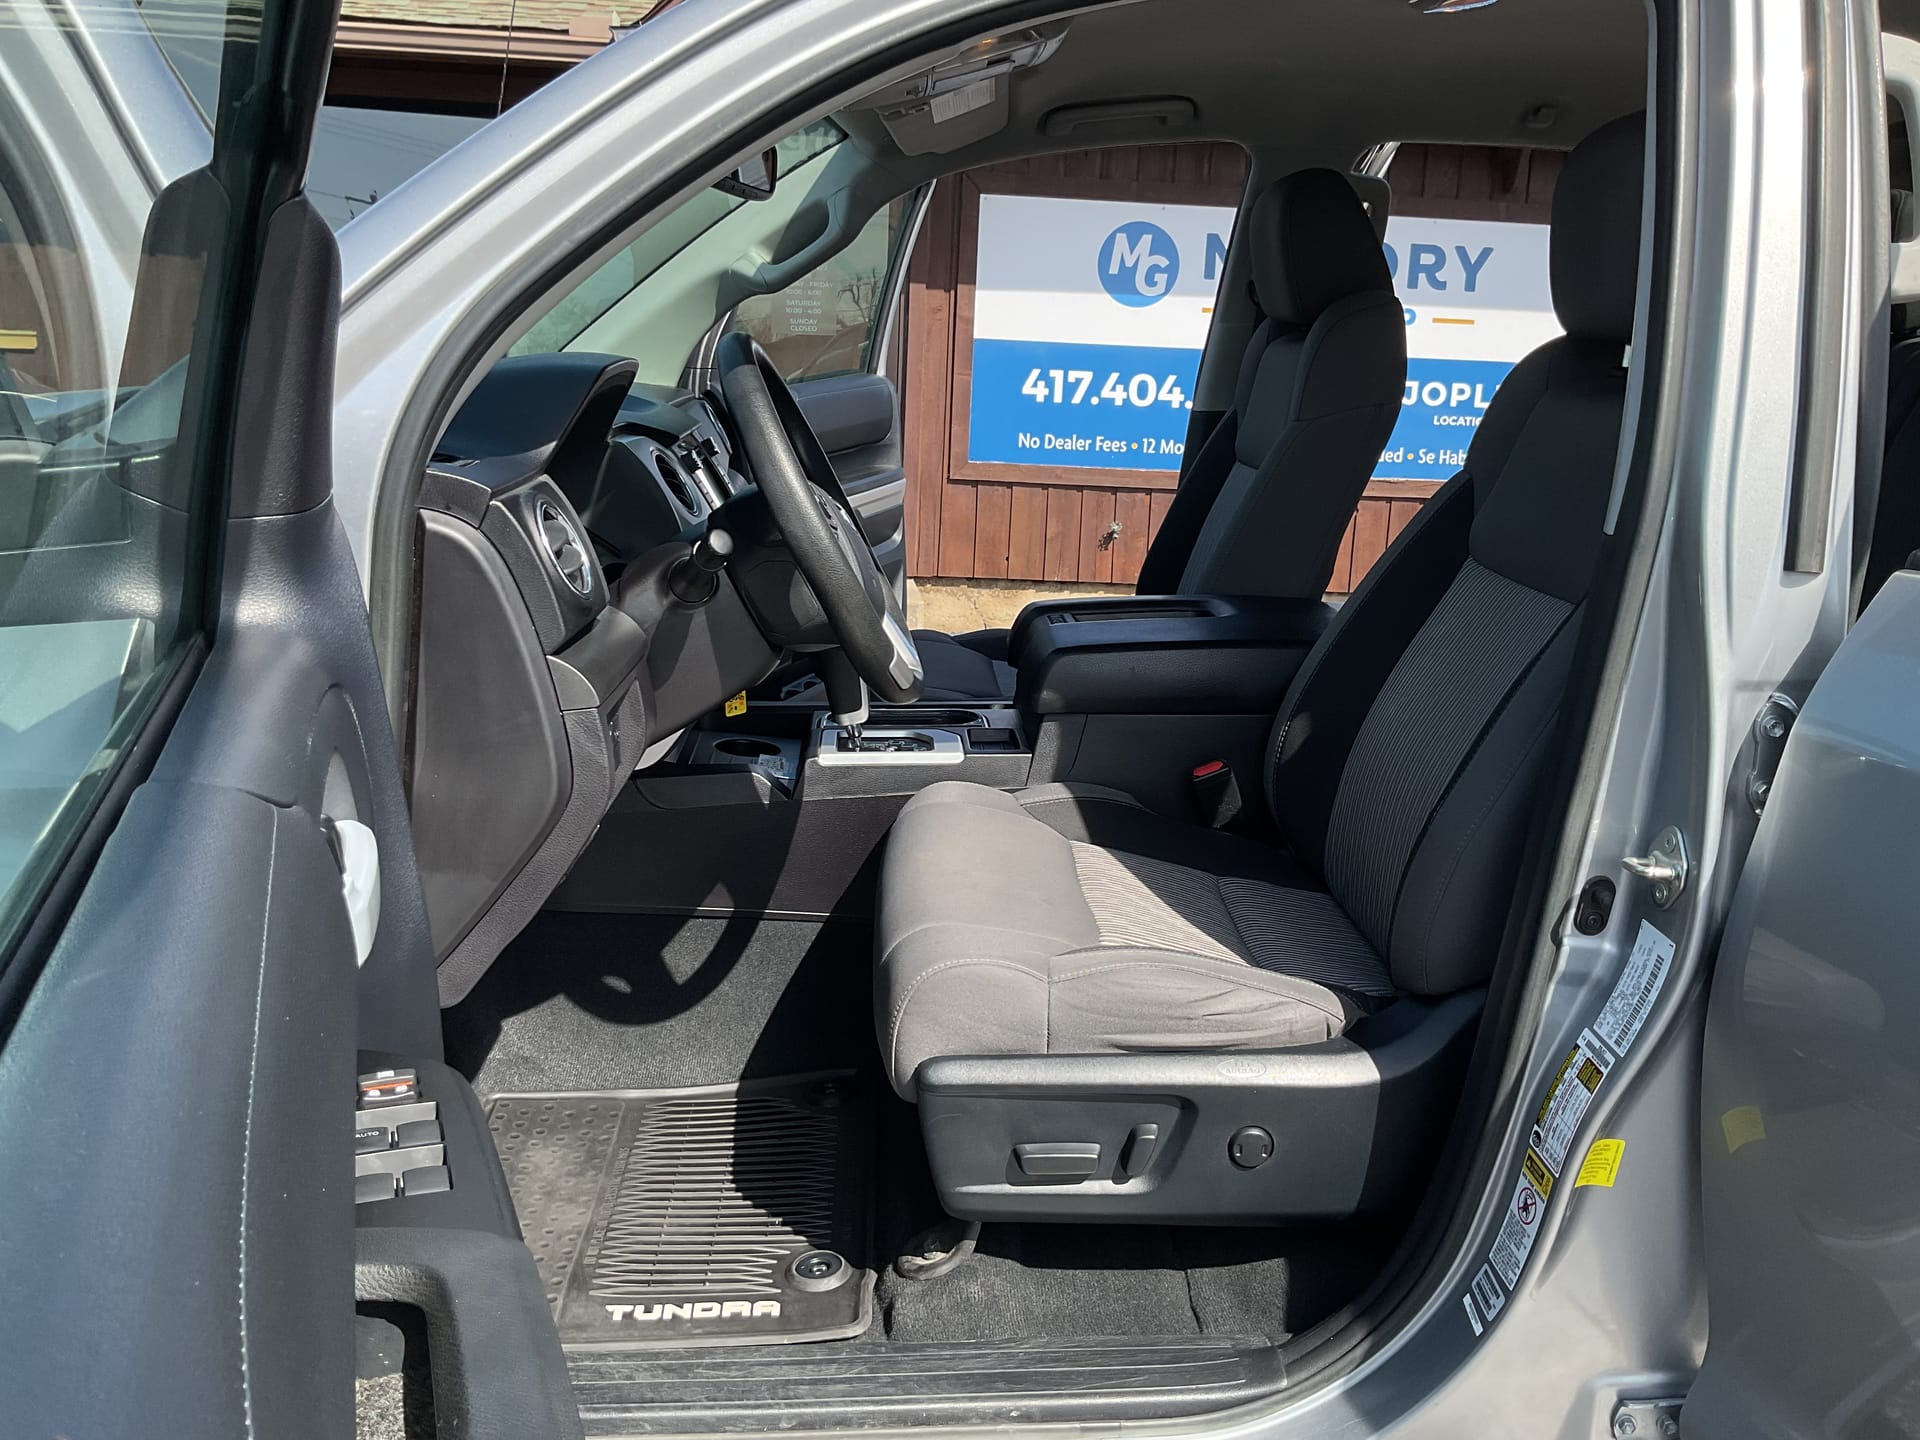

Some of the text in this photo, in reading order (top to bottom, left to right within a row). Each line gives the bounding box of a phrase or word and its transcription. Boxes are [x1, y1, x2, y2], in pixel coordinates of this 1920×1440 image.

[1108, 232, 1170, 297] MG
[1402, 380, 1501, 409] JOPL
[1018, 432, 1040, 449] No
[1044, 433, 1092, 451] Dealer
[1096, 436, 1127, 453] Fees
[1142, 438, 1156, 454] 12
[1418, 449, 1434, 465] Se
[355, 1130, 380, 1138] AUTO
[605, 1300, 781, 1321] TUNDRA
